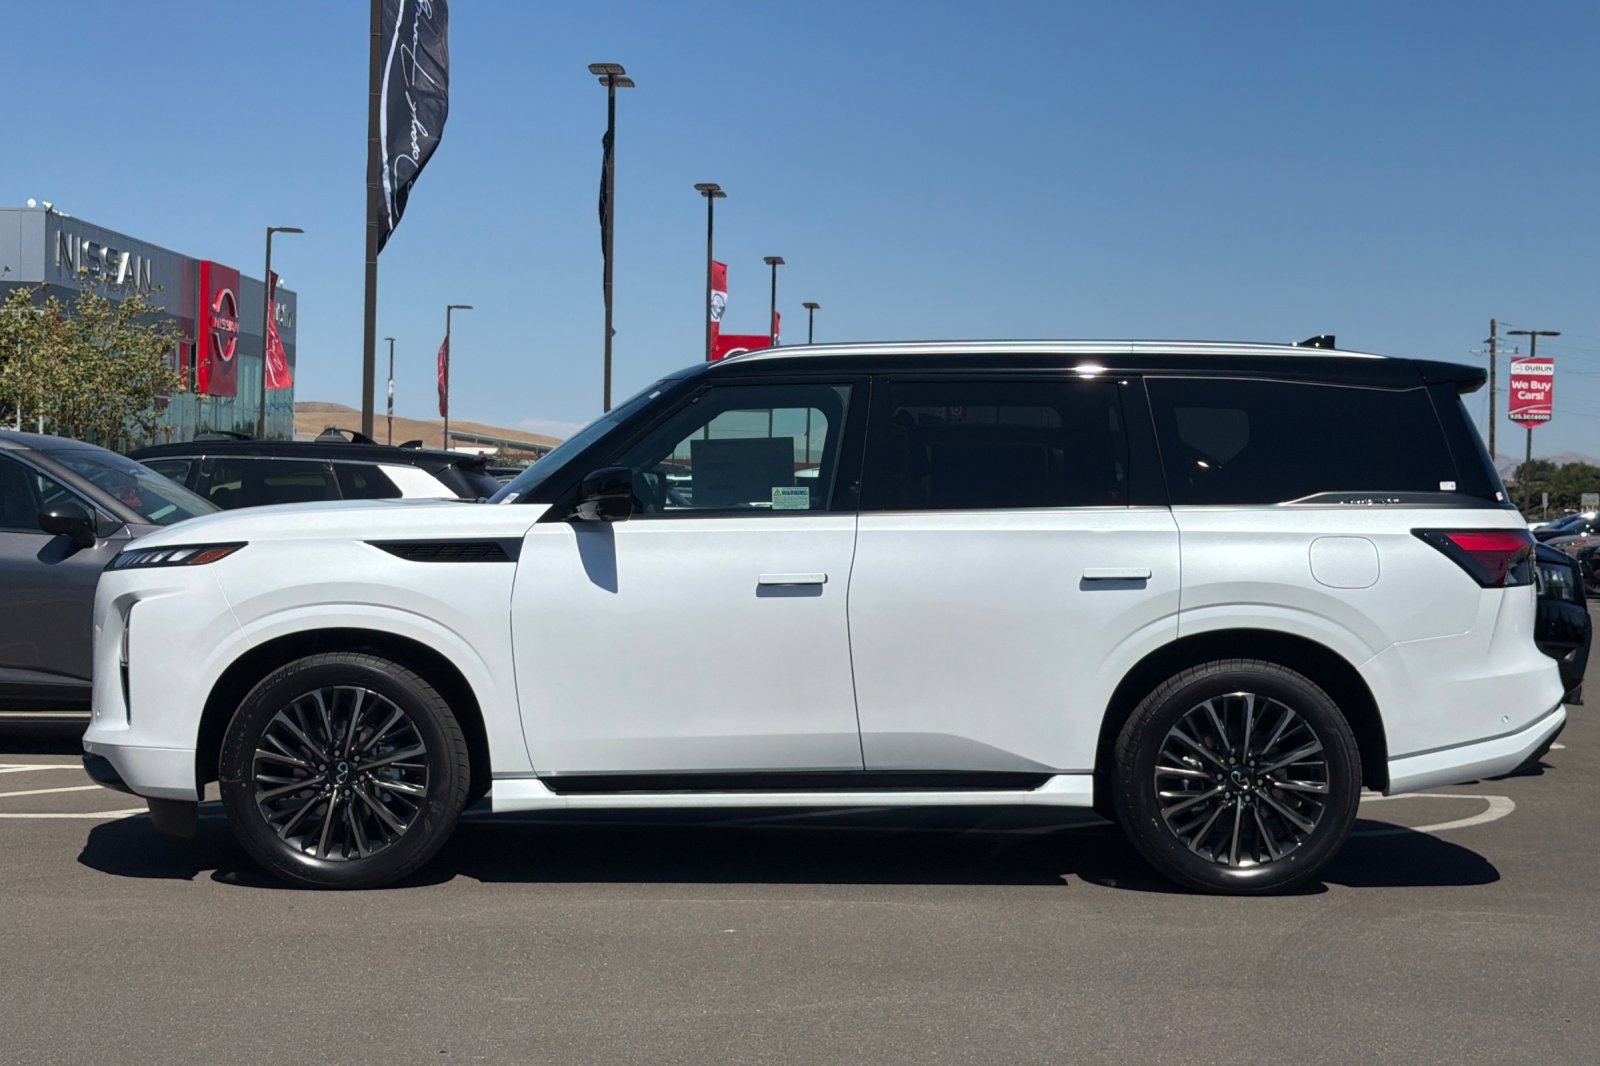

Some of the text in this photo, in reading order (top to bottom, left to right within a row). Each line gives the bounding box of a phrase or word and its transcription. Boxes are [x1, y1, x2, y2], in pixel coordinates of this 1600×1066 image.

[55, 230, 151, 291] NISSAN
[212, 317, 240, 334] NISSAN
[1511, 380, 1551, 392] We Buy
[1517, 391, 1545, 400] Cars!
